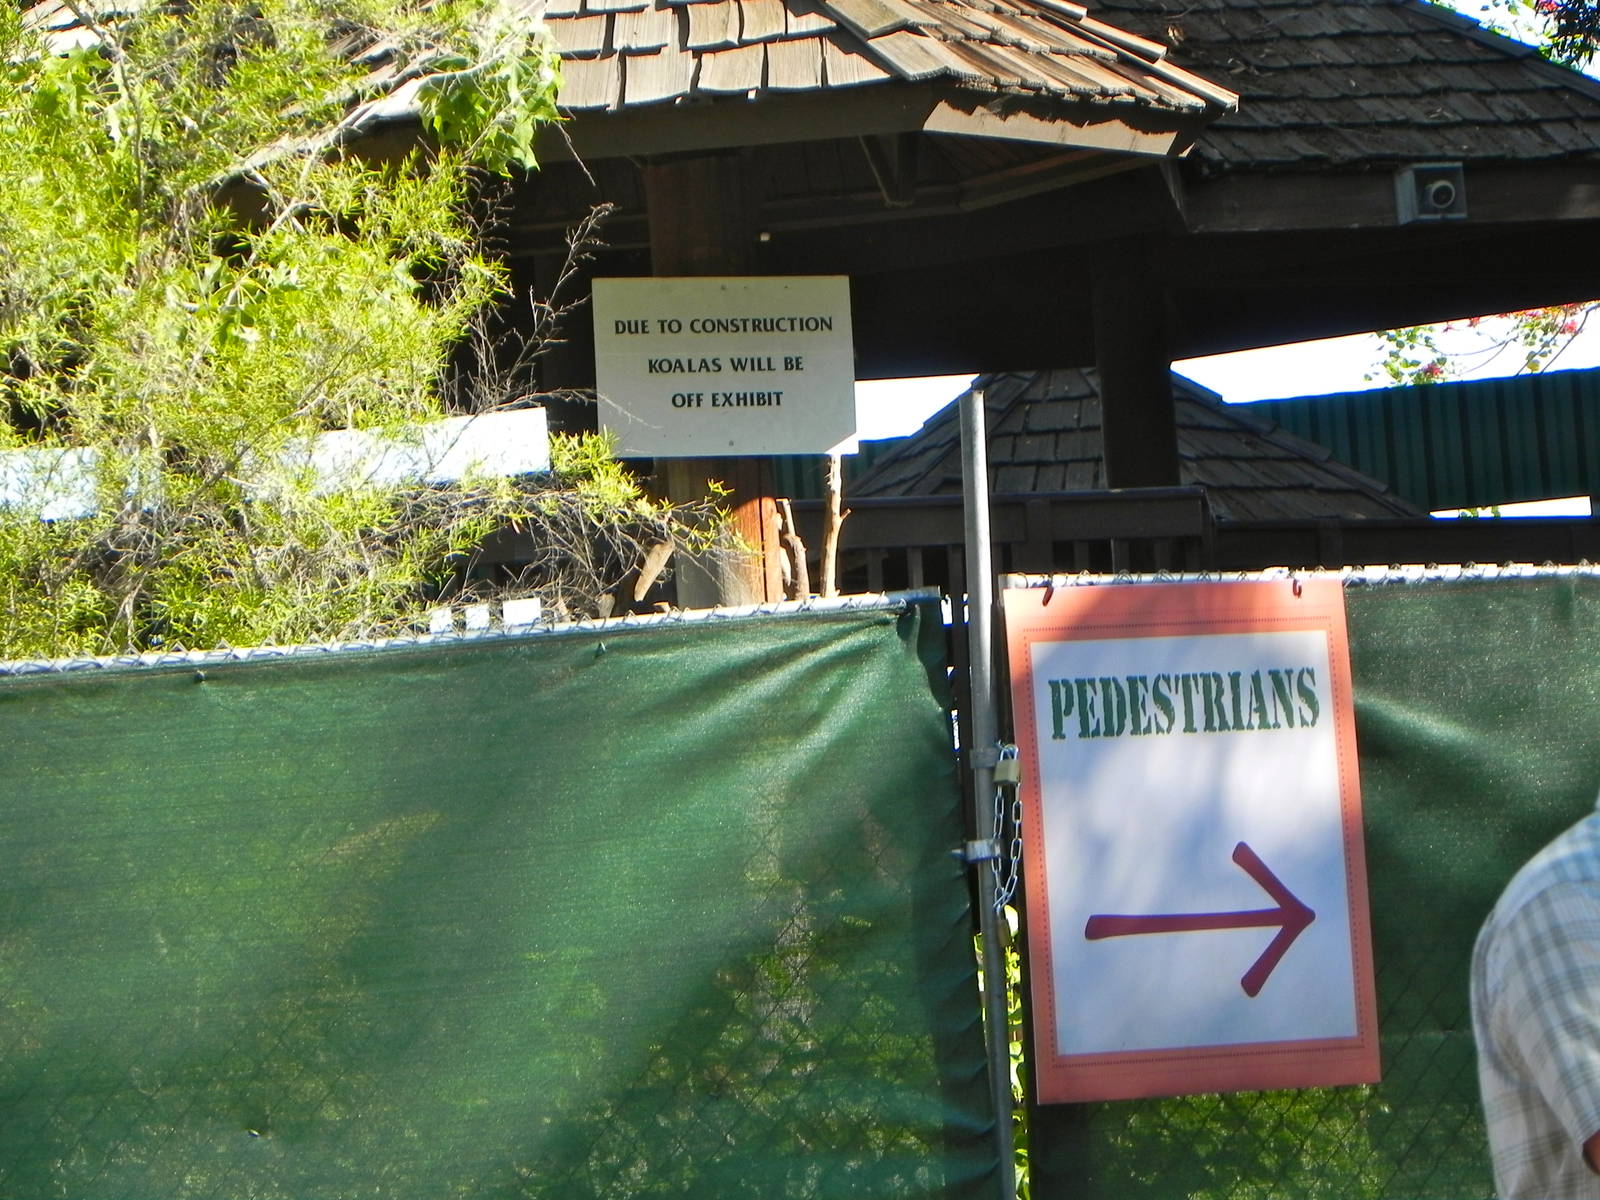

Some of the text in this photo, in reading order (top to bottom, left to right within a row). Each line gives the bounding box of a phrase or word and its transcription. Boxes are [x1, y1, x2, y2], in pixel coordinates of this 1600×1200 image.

[614, 316, 833, 335] DUE TO CONSTRUCTION
[648, 356, 804, 374] KOALAS WILL BE
[671, 391, 784, 408] OFF EXHIBIT
[1047, 666, 1321, 740] PEDESTRIANS
